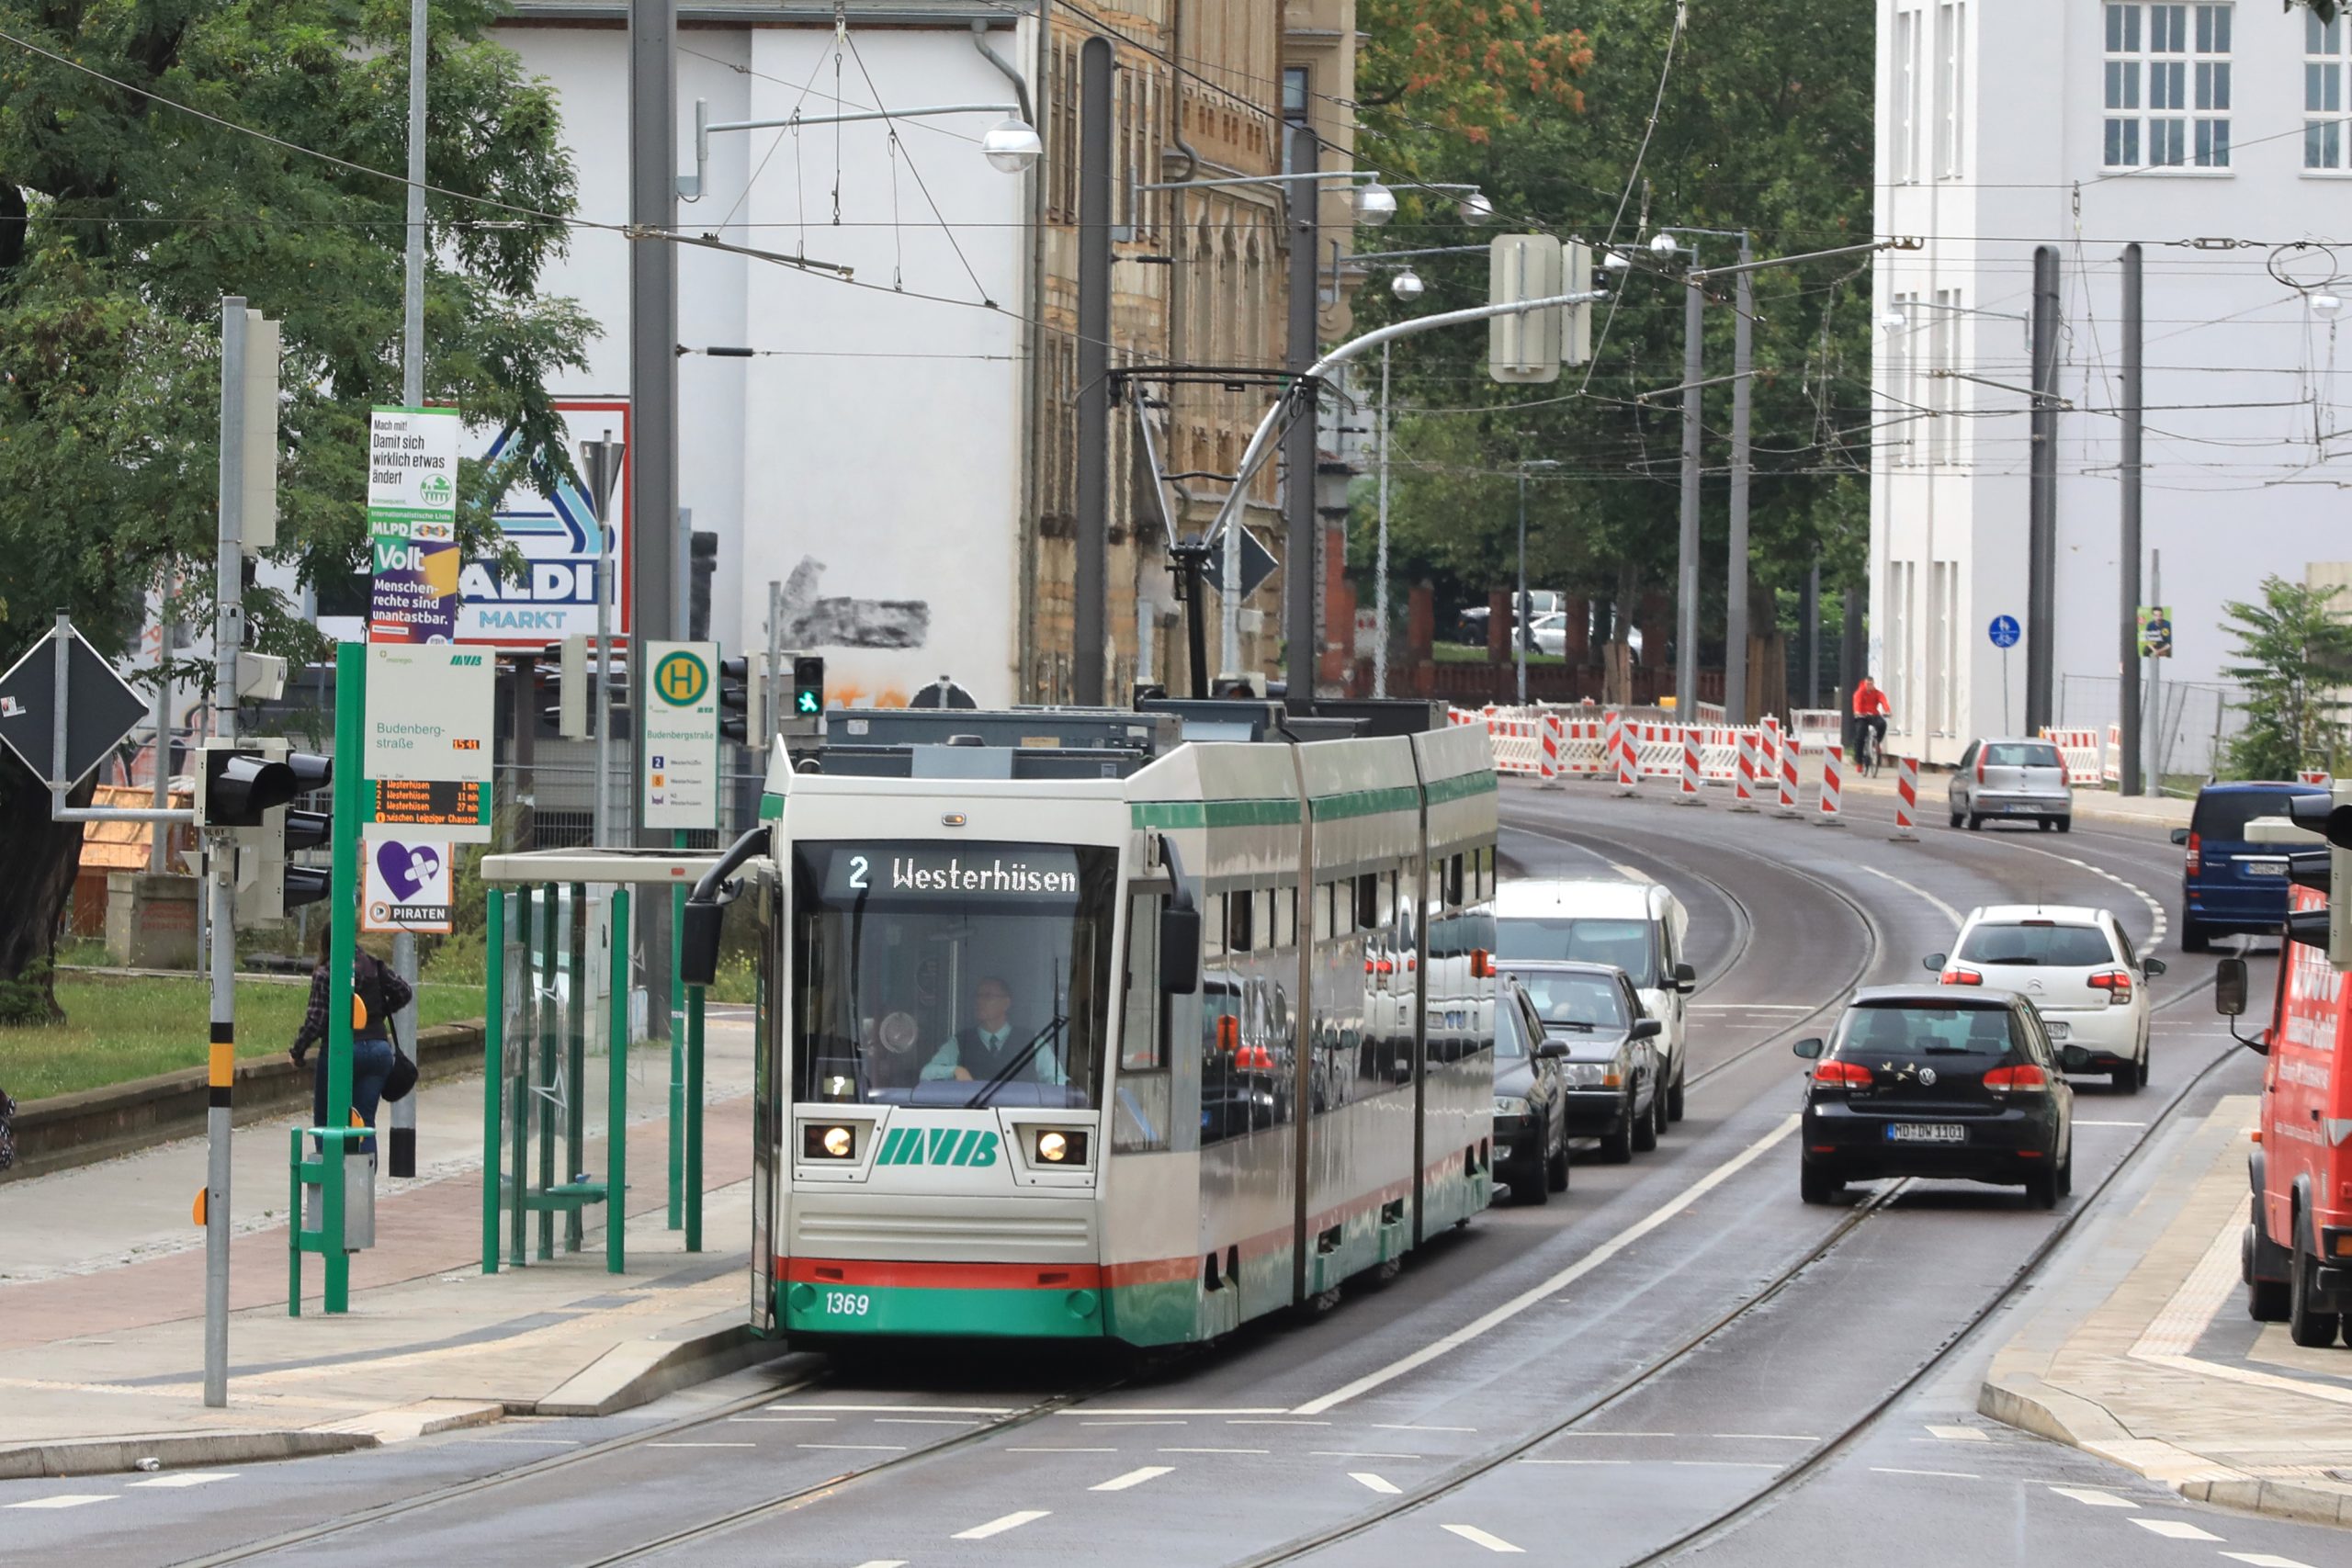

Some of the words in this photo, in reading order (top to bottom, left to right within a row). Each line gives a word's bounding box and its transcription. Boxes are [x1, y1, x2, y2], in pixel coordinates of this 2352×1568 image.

[374, 420, 392, 431] Mach
[393, 421, 408, 431] mit!
[373, 434, 400, 448] Damit
[402, 434, 424, 450] sich
[373, 452, 410, 467] wirklich
[413, 455, 445, 468] etwas
[372, 469, 402, 484] ändert
[435, 513, 451, 521] Liste
[371, 522, 410, 536] MLPD
[378, 544, 425, 571] Volt
[374, 579, 439, 594] Menschen-
[459, 563, 593, 600] ALDI
[373, 593, 410, 607] rechte
[412, 596, 439, 610] sind
[372, 610, 448, 625] unantastbar.
[480, 611, 567, 628] MARKT
[377, 722, 446, 737] Budenberg-
[647, 729, 714, 741] Budenbergstraße
[377, 739, 413, 749] straße
[377, 790, 382, 799] 2
[458, 792, 467, 800] 11
[468, 793, 478, 801] min
[377, 801, 382, 810] 2
[457, 803, 467, 812] 27
[467, 804, 478, 812] min
[849, 855, 868, 888] 2
[893, 857, 1076, 892] Westerhüsen
[393, 908, 445, 919] PIRATEN
[825, 1292, 869, 1316] 1369
